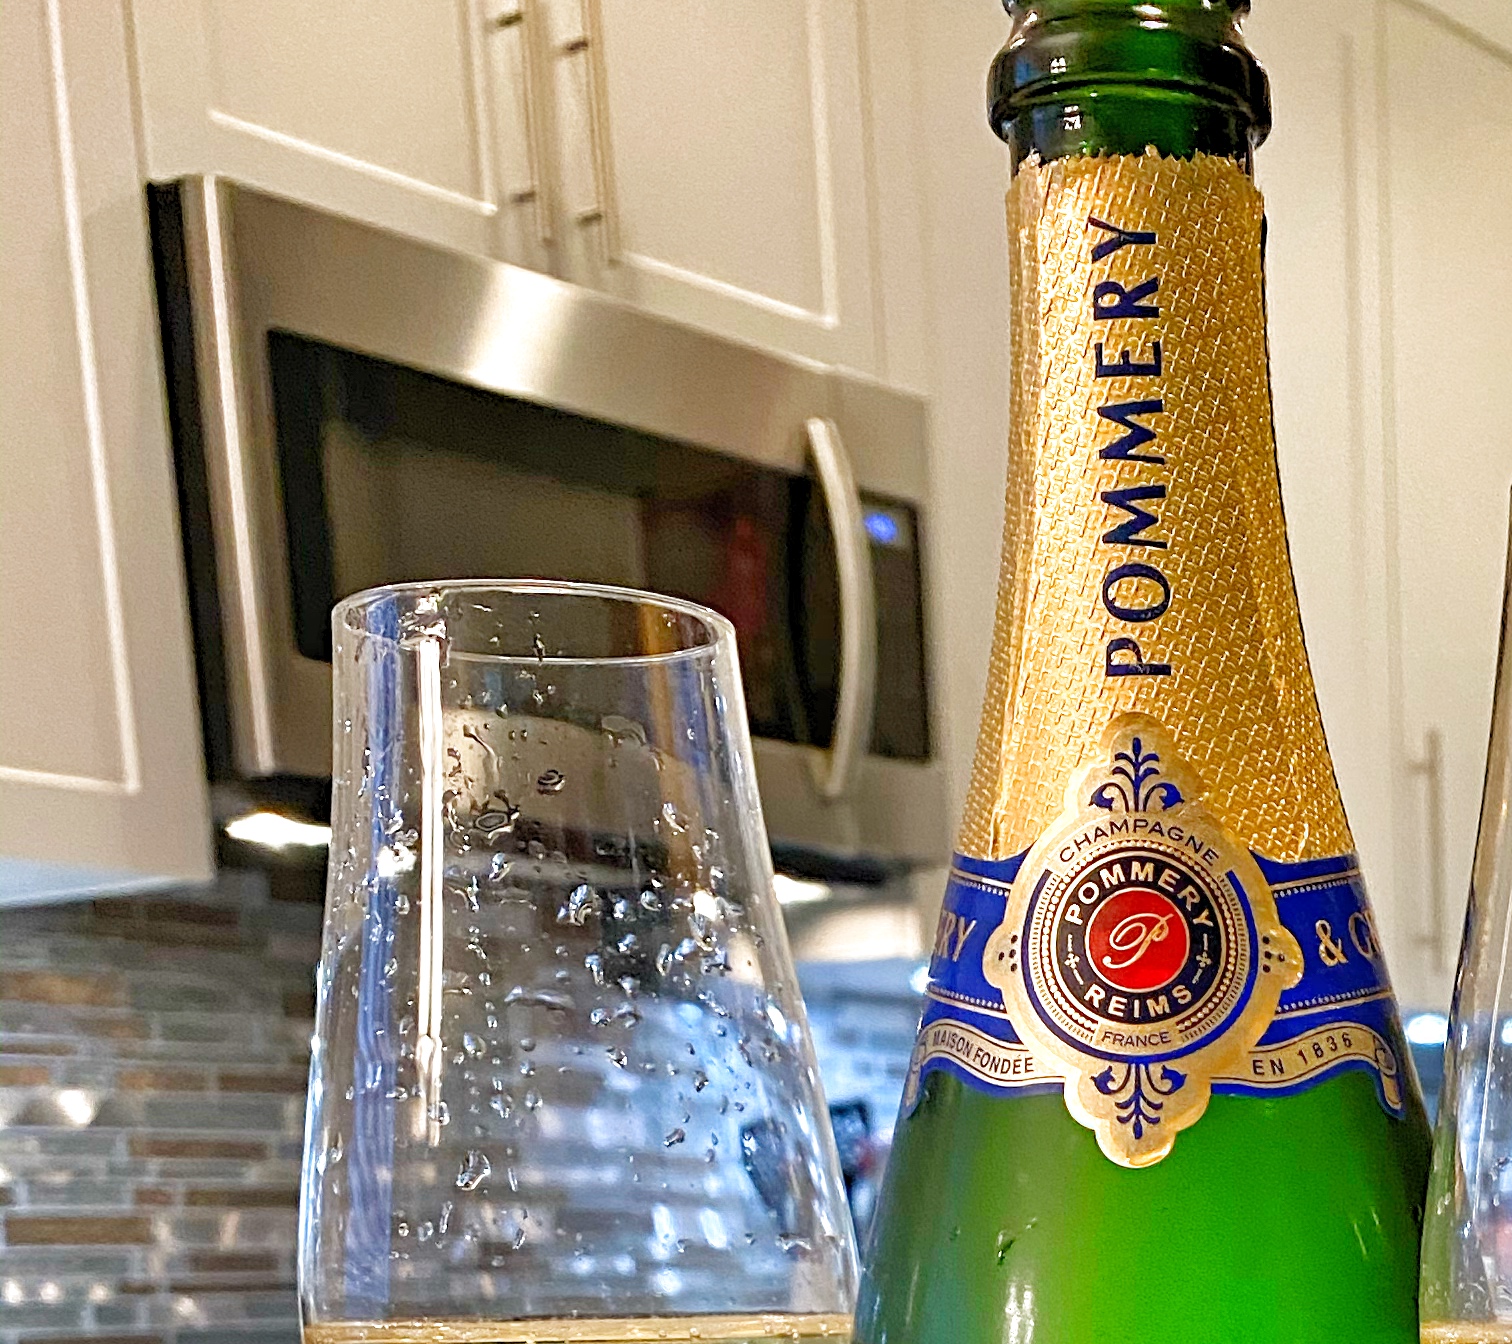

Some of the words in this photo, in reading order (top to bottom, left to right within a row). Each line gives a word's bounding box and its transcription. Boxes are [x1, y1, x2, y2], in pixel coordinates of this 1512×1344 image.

[1087, 215, 1172, 677] POMMERY
[1059, 818, 1220, 867] CHAMPAGNE
[1064, 860, 1214, 928] POMMERY
[1315, 919, 1349, 967] &
[1083, 983, 1193, 1019] REIMS
[933, 1029, 975, 1060] MAISON
[972, 1048, 1035, 1075] FONDÉE
[1252, 1058, 1285, 1077] EN
[1297, 1031, 1353, 1066] 1836
[1100, 1031, 1172, 1048] FRANCE
